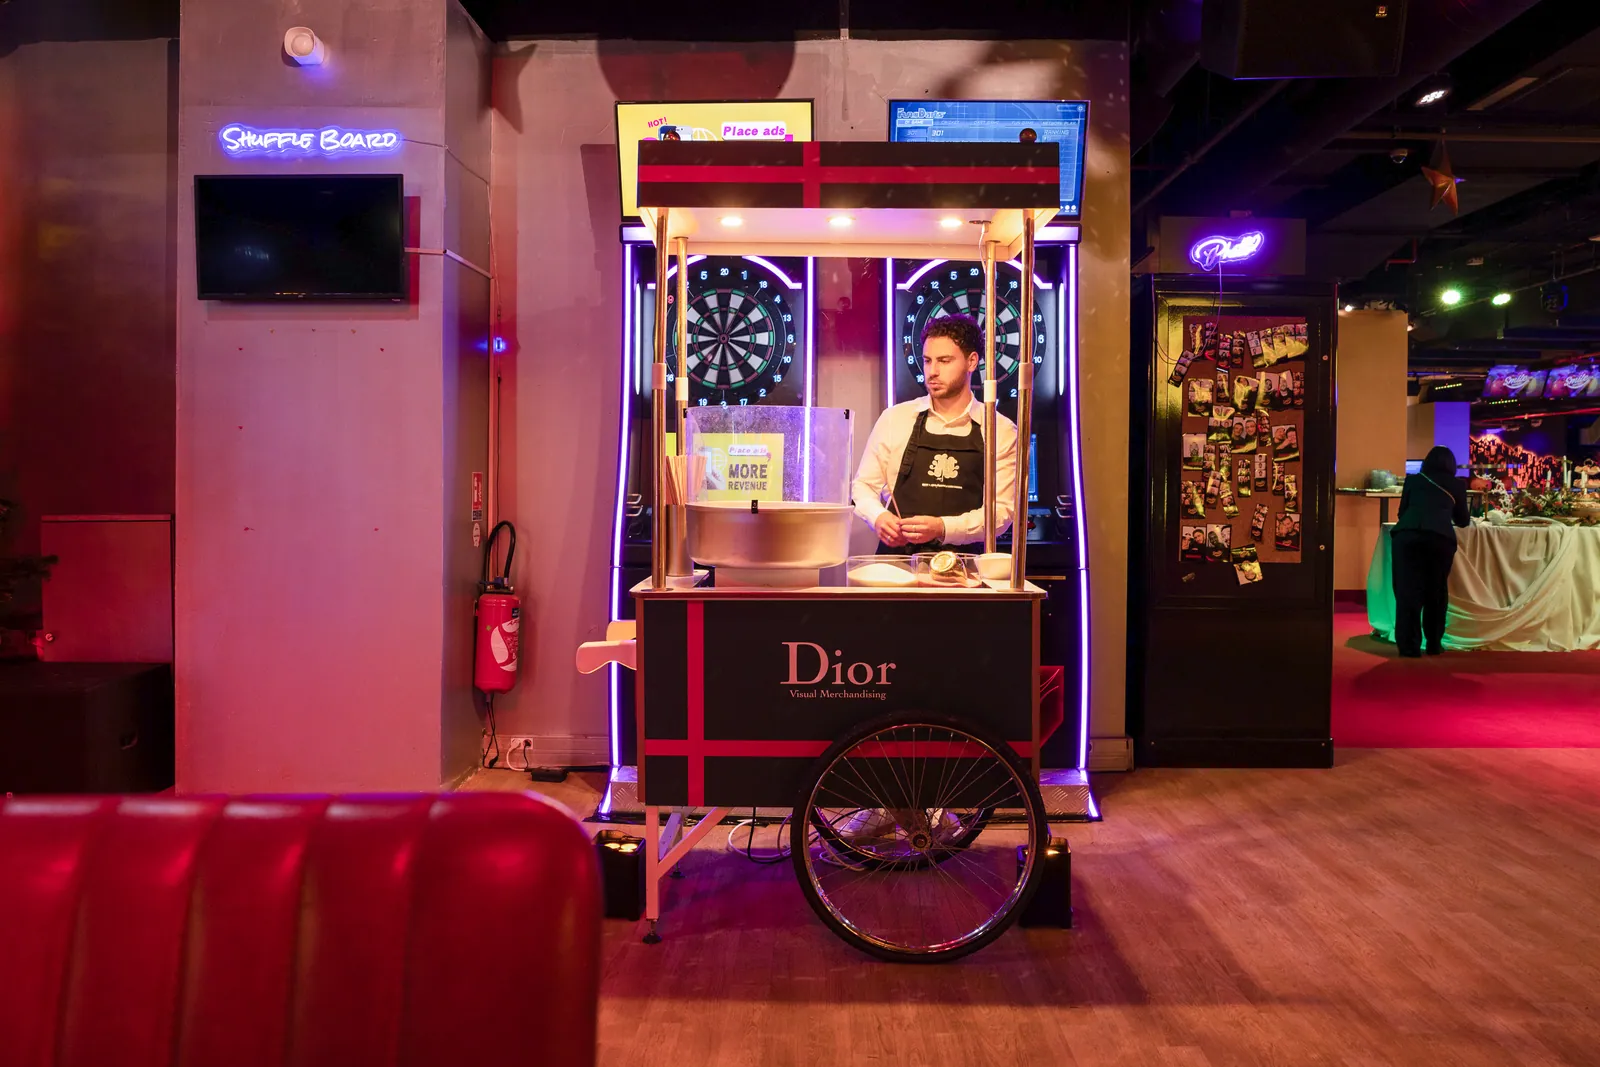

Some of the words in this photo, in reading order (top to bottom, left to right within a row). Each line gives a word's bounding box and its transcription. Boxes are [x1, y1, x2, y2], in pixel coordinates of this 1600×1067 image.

[647, 117, 668, 128] HOT!
[723, 126, 759, 136] Place
[762, 126, 785, 136] ads
[319, 129, 397, 151] BOARD
[700, 271, 708, 280] 5
[720, 268, 729, 276] 20
[741, 271, 748, 280] 1
[950, 271, 958, 281] 5
[970, 268, 979, 276] 20
[930, 281, 939, 289] 12
[1009, 281, 1018, 289] 18
[774, 295, 781, 303] 4
[916, 295, 924, 304] 9
[906, 315, 915, 323] 14
[787, 334, 794, 343] 6
[903, 335, 912, 344] 11
[1038, 334, 1045, 344] 6
[907, 355, 915, 365] 8
[1033, 356, 1042, 364] 10
[773, 374, 782, 382] 15
[759, 388, 767, 397] 2
[1010, 388, 1018, 397] 2
[698, 398, 708, 406] 19
[740, 398, 748, 406] 17
[729, 446, 752, 454] Place
[728, 463, 768, 479] MORE
[728, 481, 768, 491] REVENUE
[780, 641, 897, 686] Dior
[789, 689, 817, 698] Visual
[820, 689, 887, 700] Merchandising
